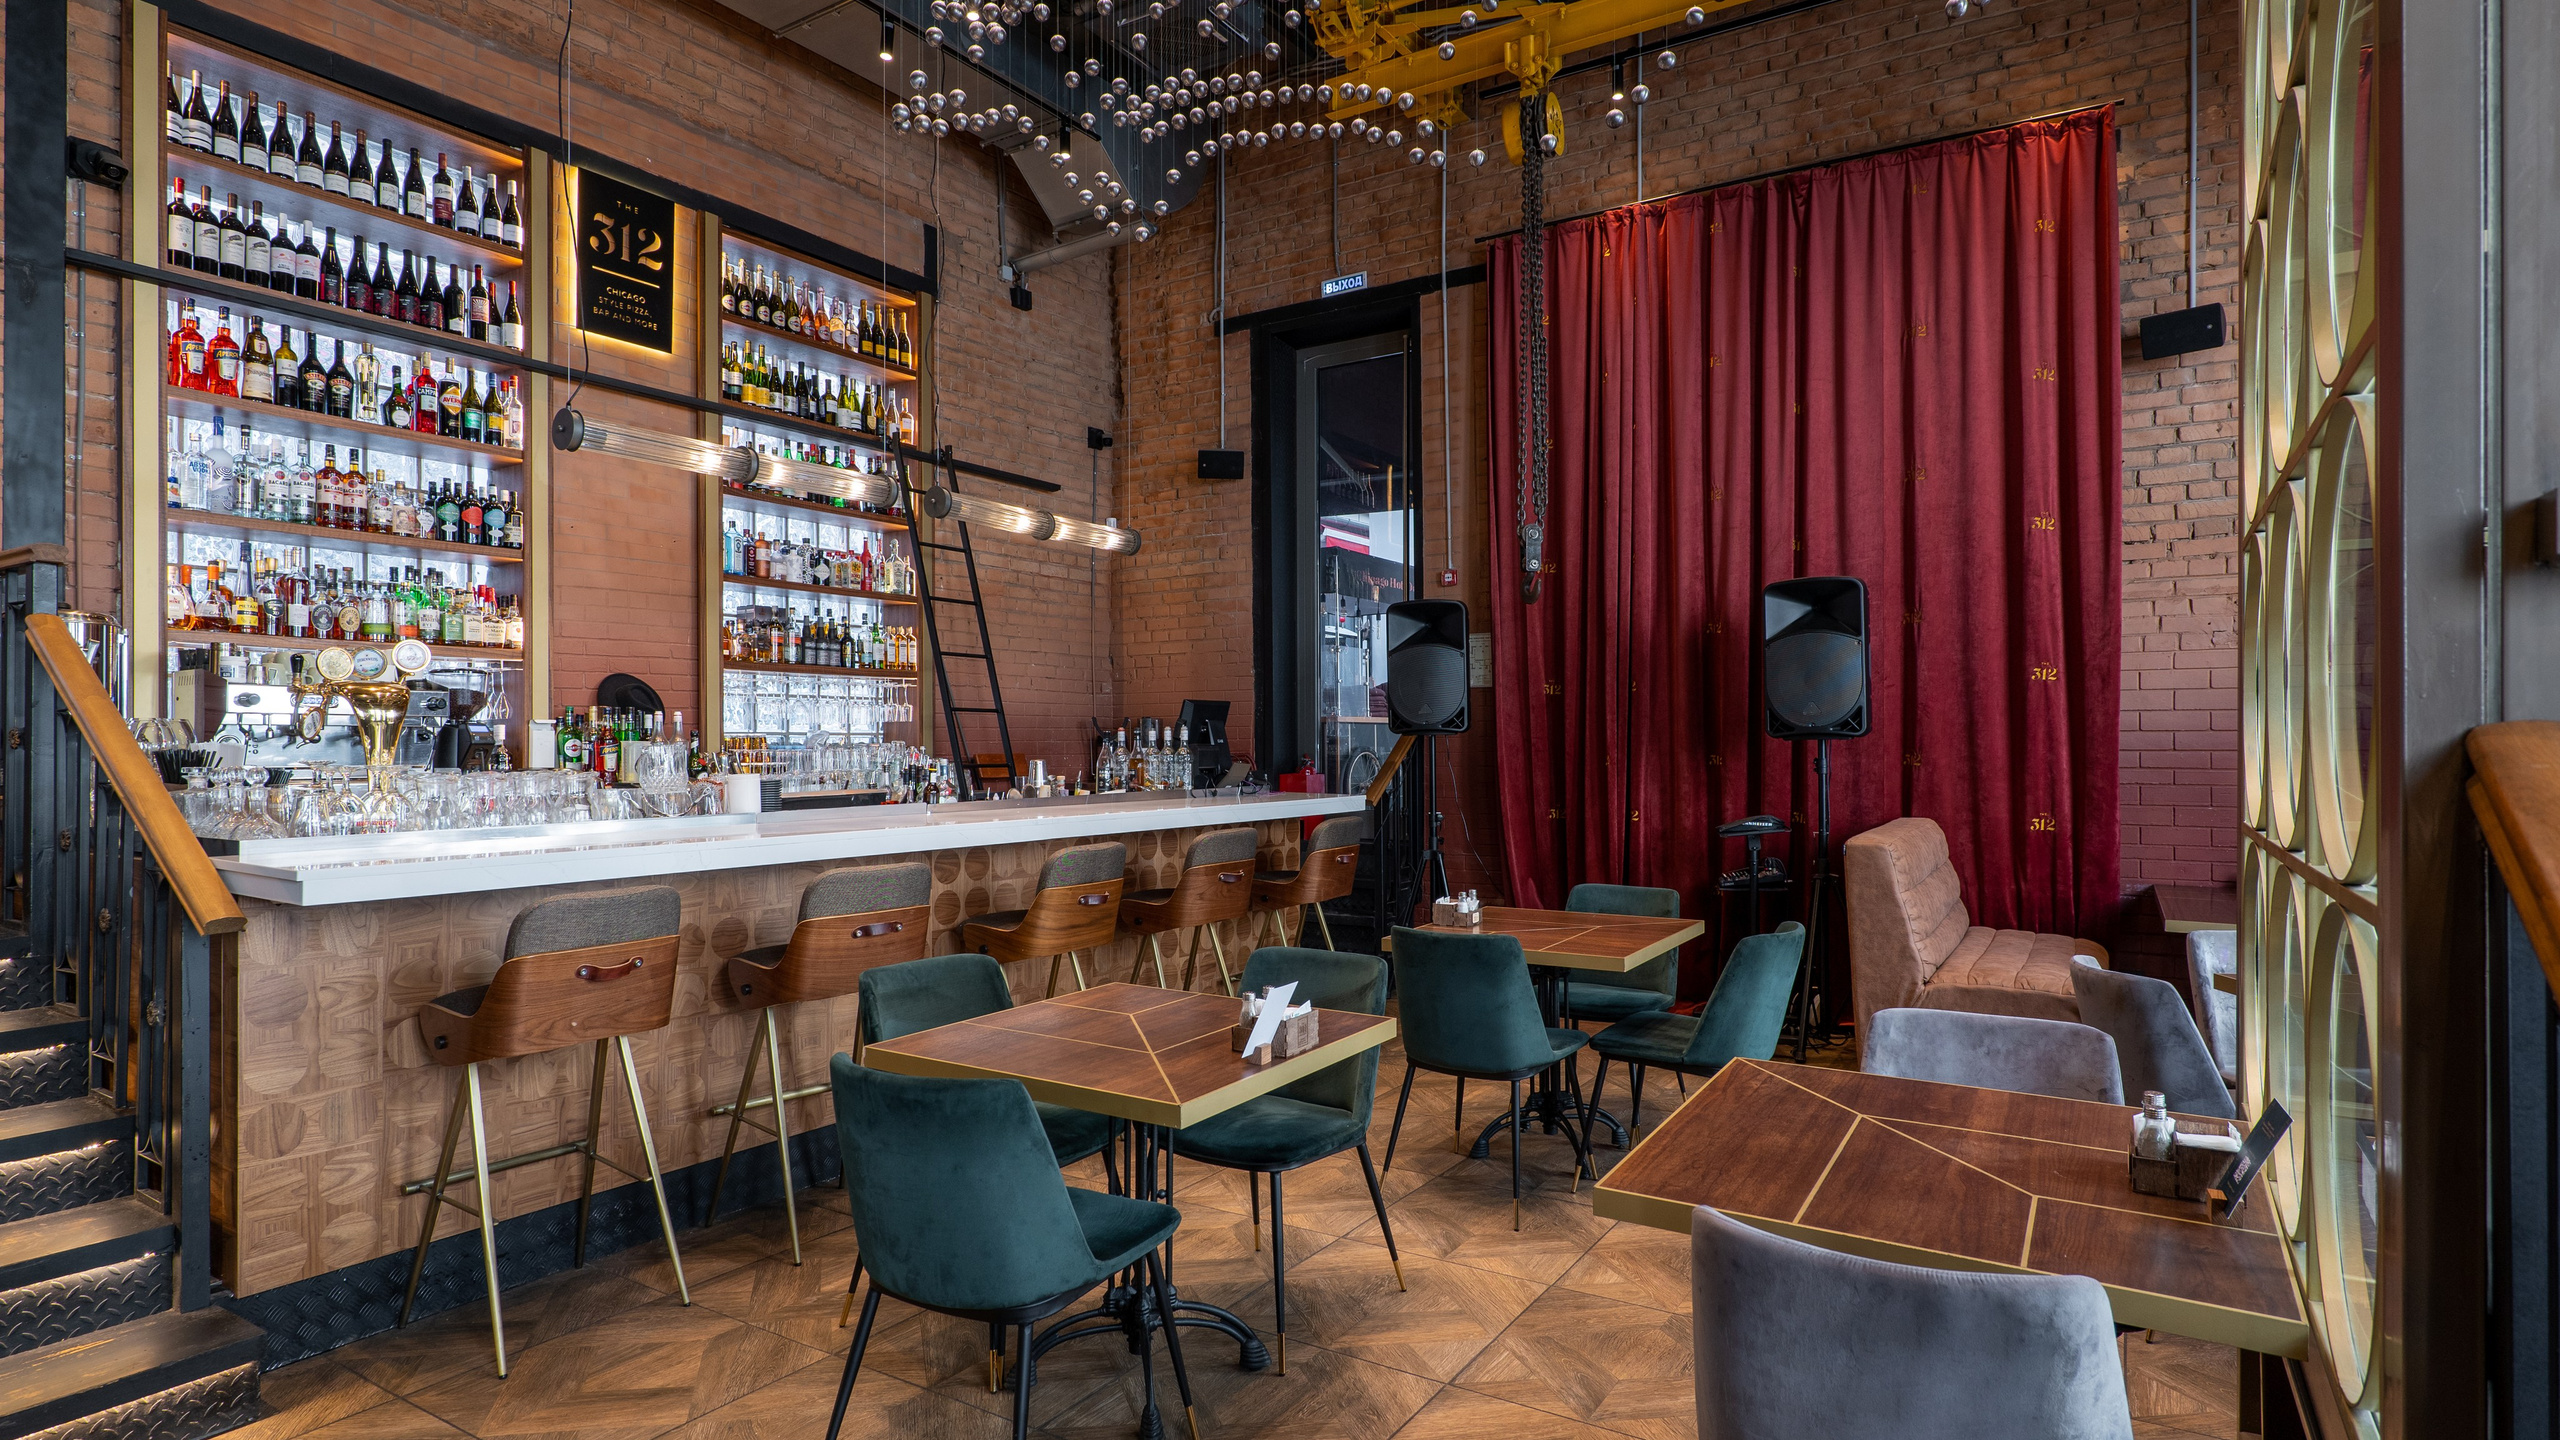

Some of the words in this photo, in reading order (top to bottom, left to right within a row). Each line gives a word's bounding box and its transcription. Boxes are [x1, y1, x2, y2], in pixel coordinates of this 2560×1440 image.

[616, 200, 639, 215] THE
[2033, 219, 2056, 233] 312
[589, 212, 663, 271] 312
[1325, 276, 1363, 294] ВЫХОД
[606, 286, 646, 304] CHICAGO
[598, 296, 624, 310] STYLE
[593, 306, 610, 317] BAR
[612, 312, 631, 324] AND
[634, 318, 658, 331] MORE
[2033, 367, 2055, 382] 312
[2031, 516, 2056, 531] 312
[2031, 667, 2058, 681] 312
[1543, 683, 1562, 695] 312
[2030, 817, 2056, 831] 312
